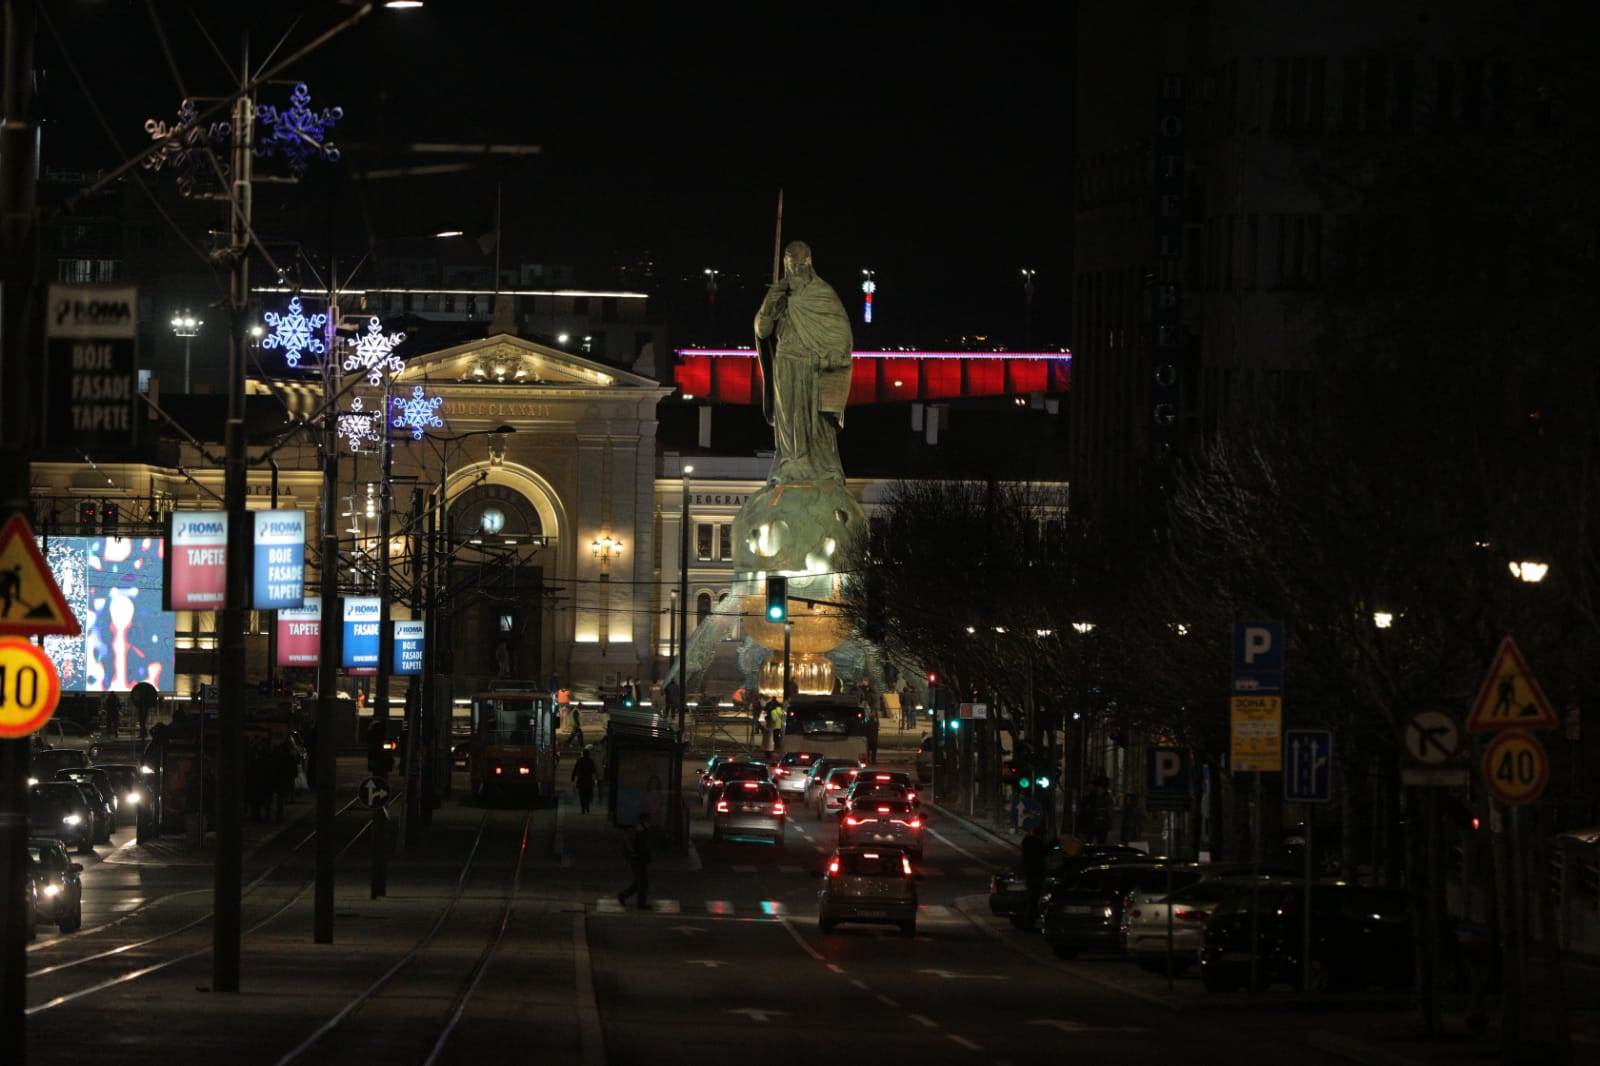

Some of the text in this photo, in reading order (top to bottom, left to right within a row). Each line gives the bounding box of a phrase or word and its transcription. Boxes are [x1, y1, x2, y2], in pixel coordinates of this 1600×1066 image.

[72, 343, 112, 369] BOJE
[72, 374, 131, 401] FASADE
[72, 404, 129, 431] TAPETE
[188, 523, 224, 534] ROMA
[270, 522, 302, 532] ROMA
[187, 549, 225, 566] TAPETE
[268, 548, 293, 564] BOJE
[268, 566, 303, 582] FASADE
[268, 584, 301, 600] TAPETE
[355, 606, 378, 614] ROMA
[288, 623, 319, 636] TAPETE
[353, 624, 379, 636] FASADE
[403, 641, 417, 650] BOJE
[1244, 627, 1273, 664] P
[403, 651, 423, 660] FASADE
[402, 661, 421, 671] TAPETE
[1154, 751, 1181, 787] P
[1498, 750, 1535, 784] 40
